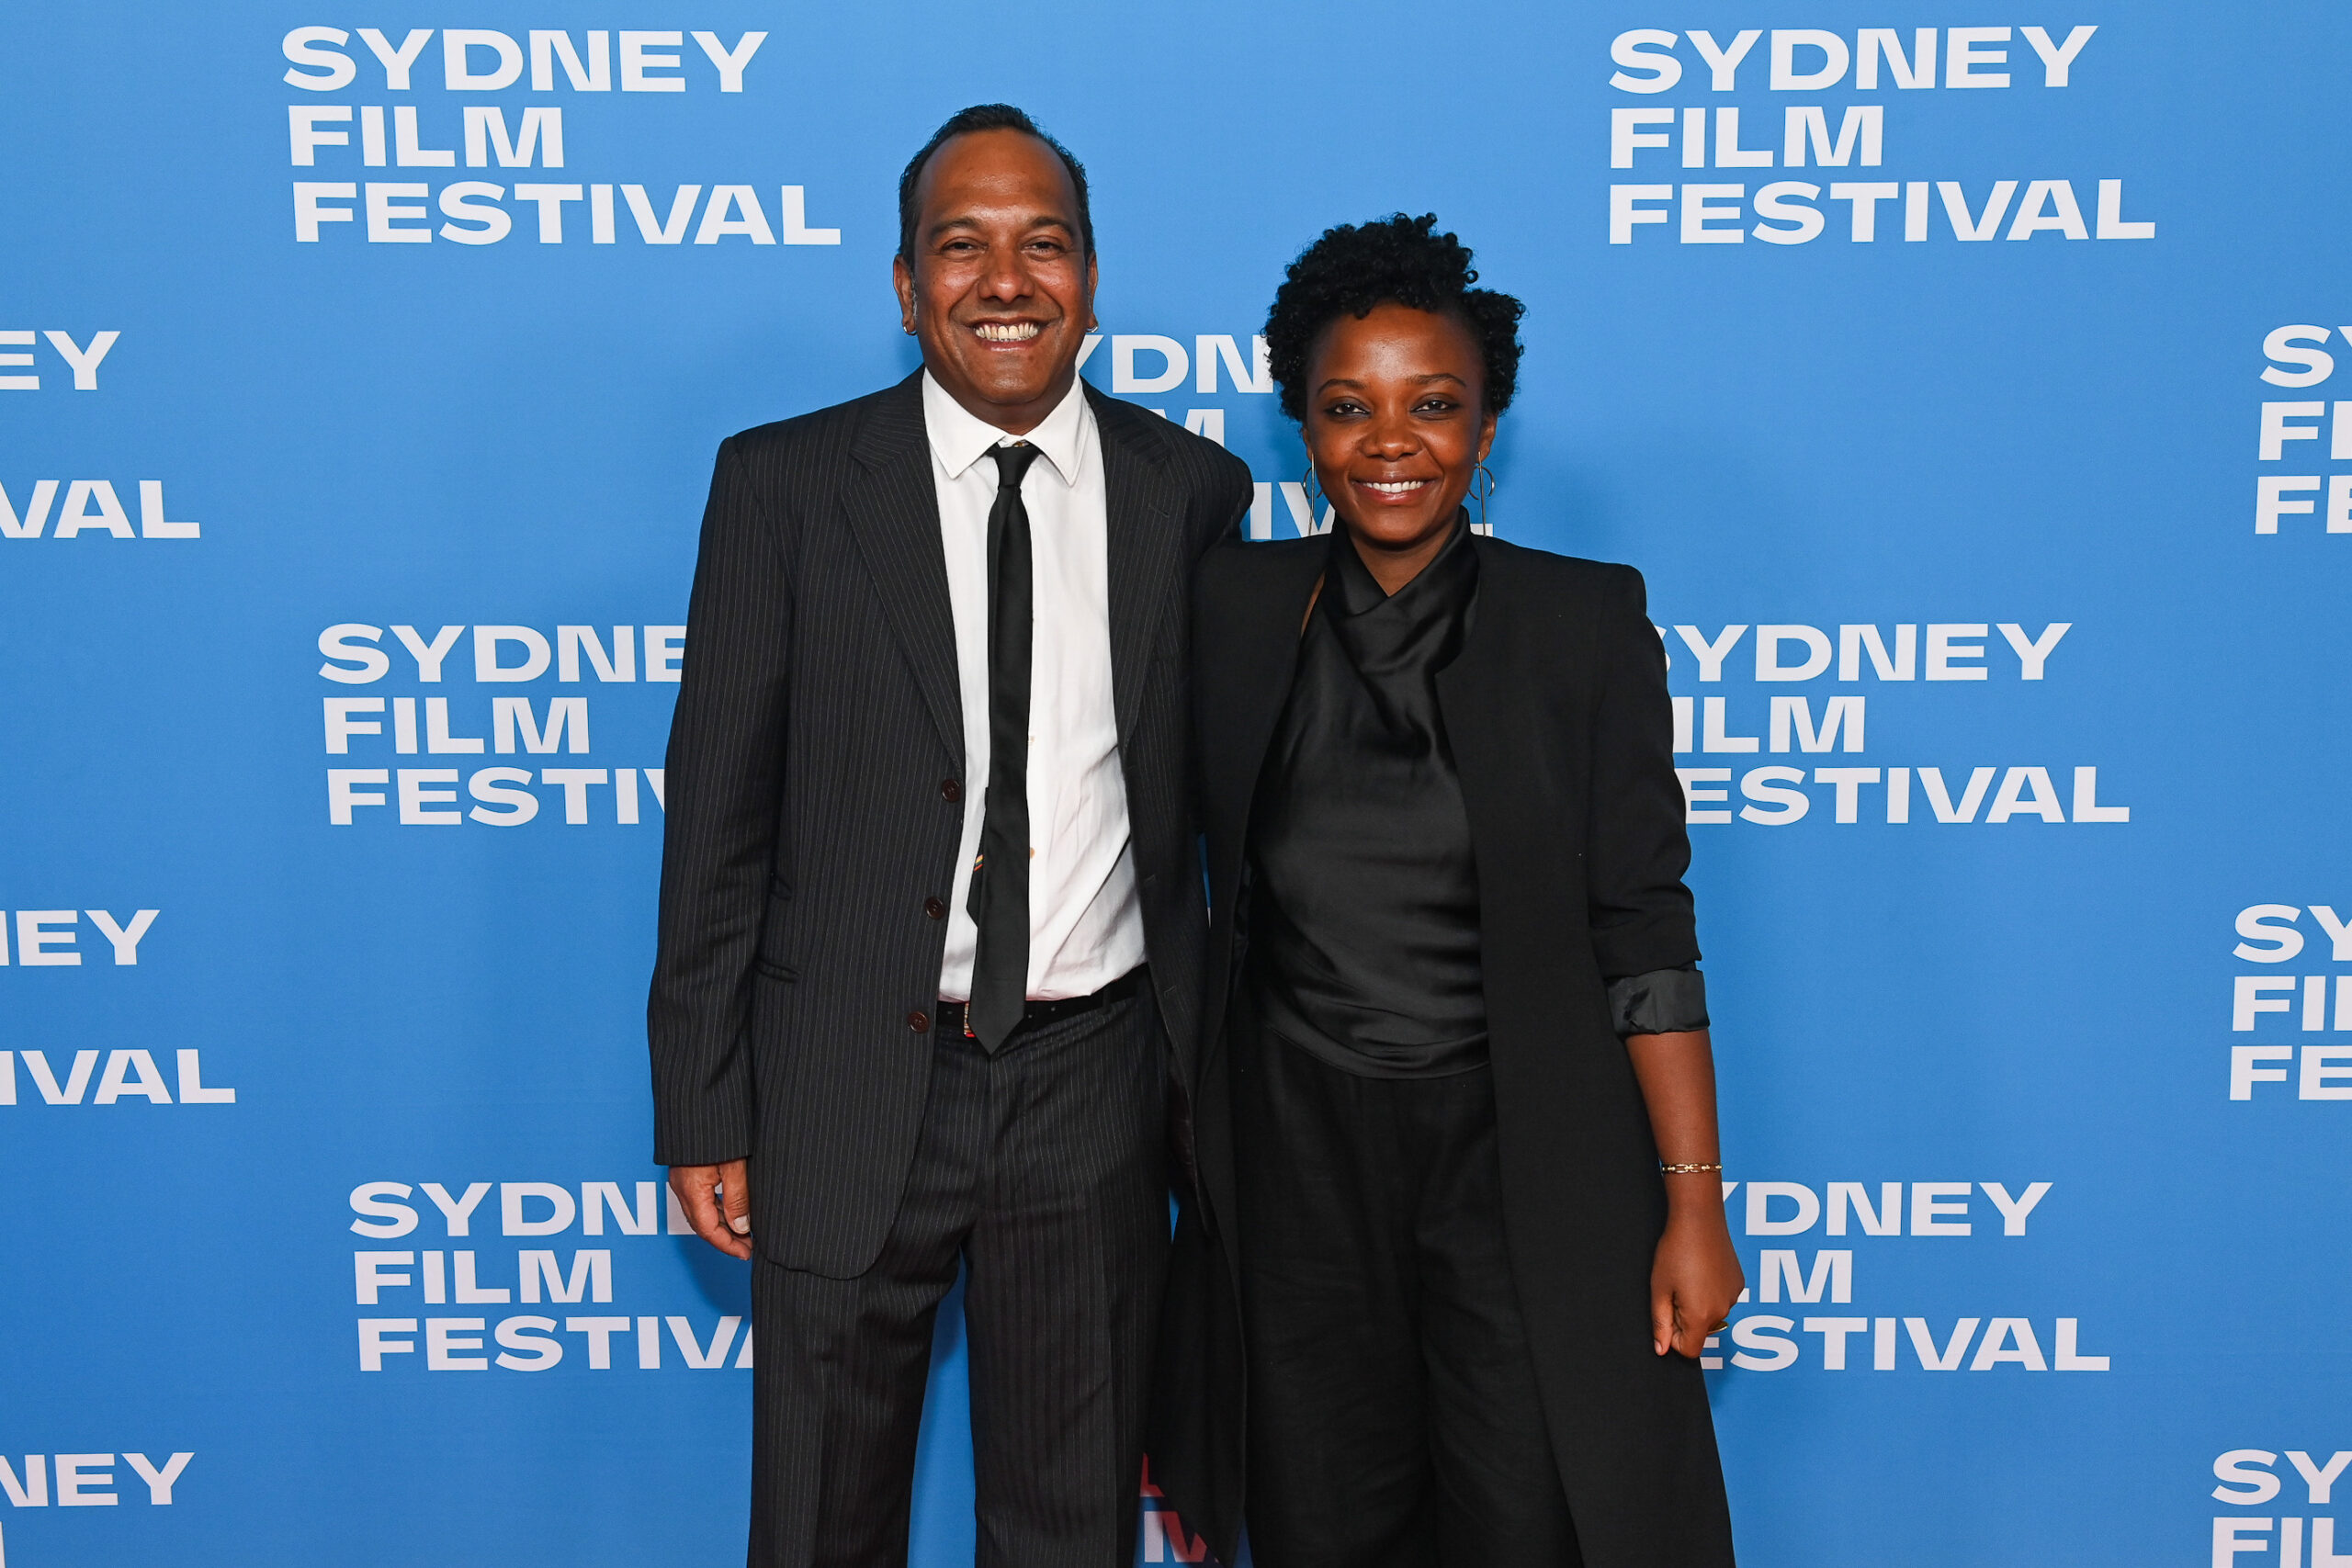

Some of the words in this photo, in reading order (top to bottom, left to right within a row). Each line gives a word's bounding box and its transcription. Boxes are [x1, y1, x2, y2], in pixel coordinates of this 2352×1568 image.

[283, 26, 769, 95] SYDNEY
[1610, 25, 2098, 95] SYDNEY
[288, 105, 564, 168] FILM
[1611, 105, 1883, 169] FILM
[292, 181, 842, 245] FESTIVAL
[1609, 178, 2156, 245] FESTIVAL
[2259, 324, 2352, 389] S
[1654, 622, 2074, 682] YDNEY
[322, 696, 589, 754] FILM
[327, 766, 664, 827] FESTI
[1674, 765, 2131, 826] ESTIVAL
[0, 908, 161, 966] EY
[1721, 1180, 2053, 1237] DNEY
[354, 1249, 613, 1305] FILM
[1737, 1249, 1853, 1303] M
[357, 1314, 752, 1372] FESTIV
[2211, 1449, 2352, 1506] SY
